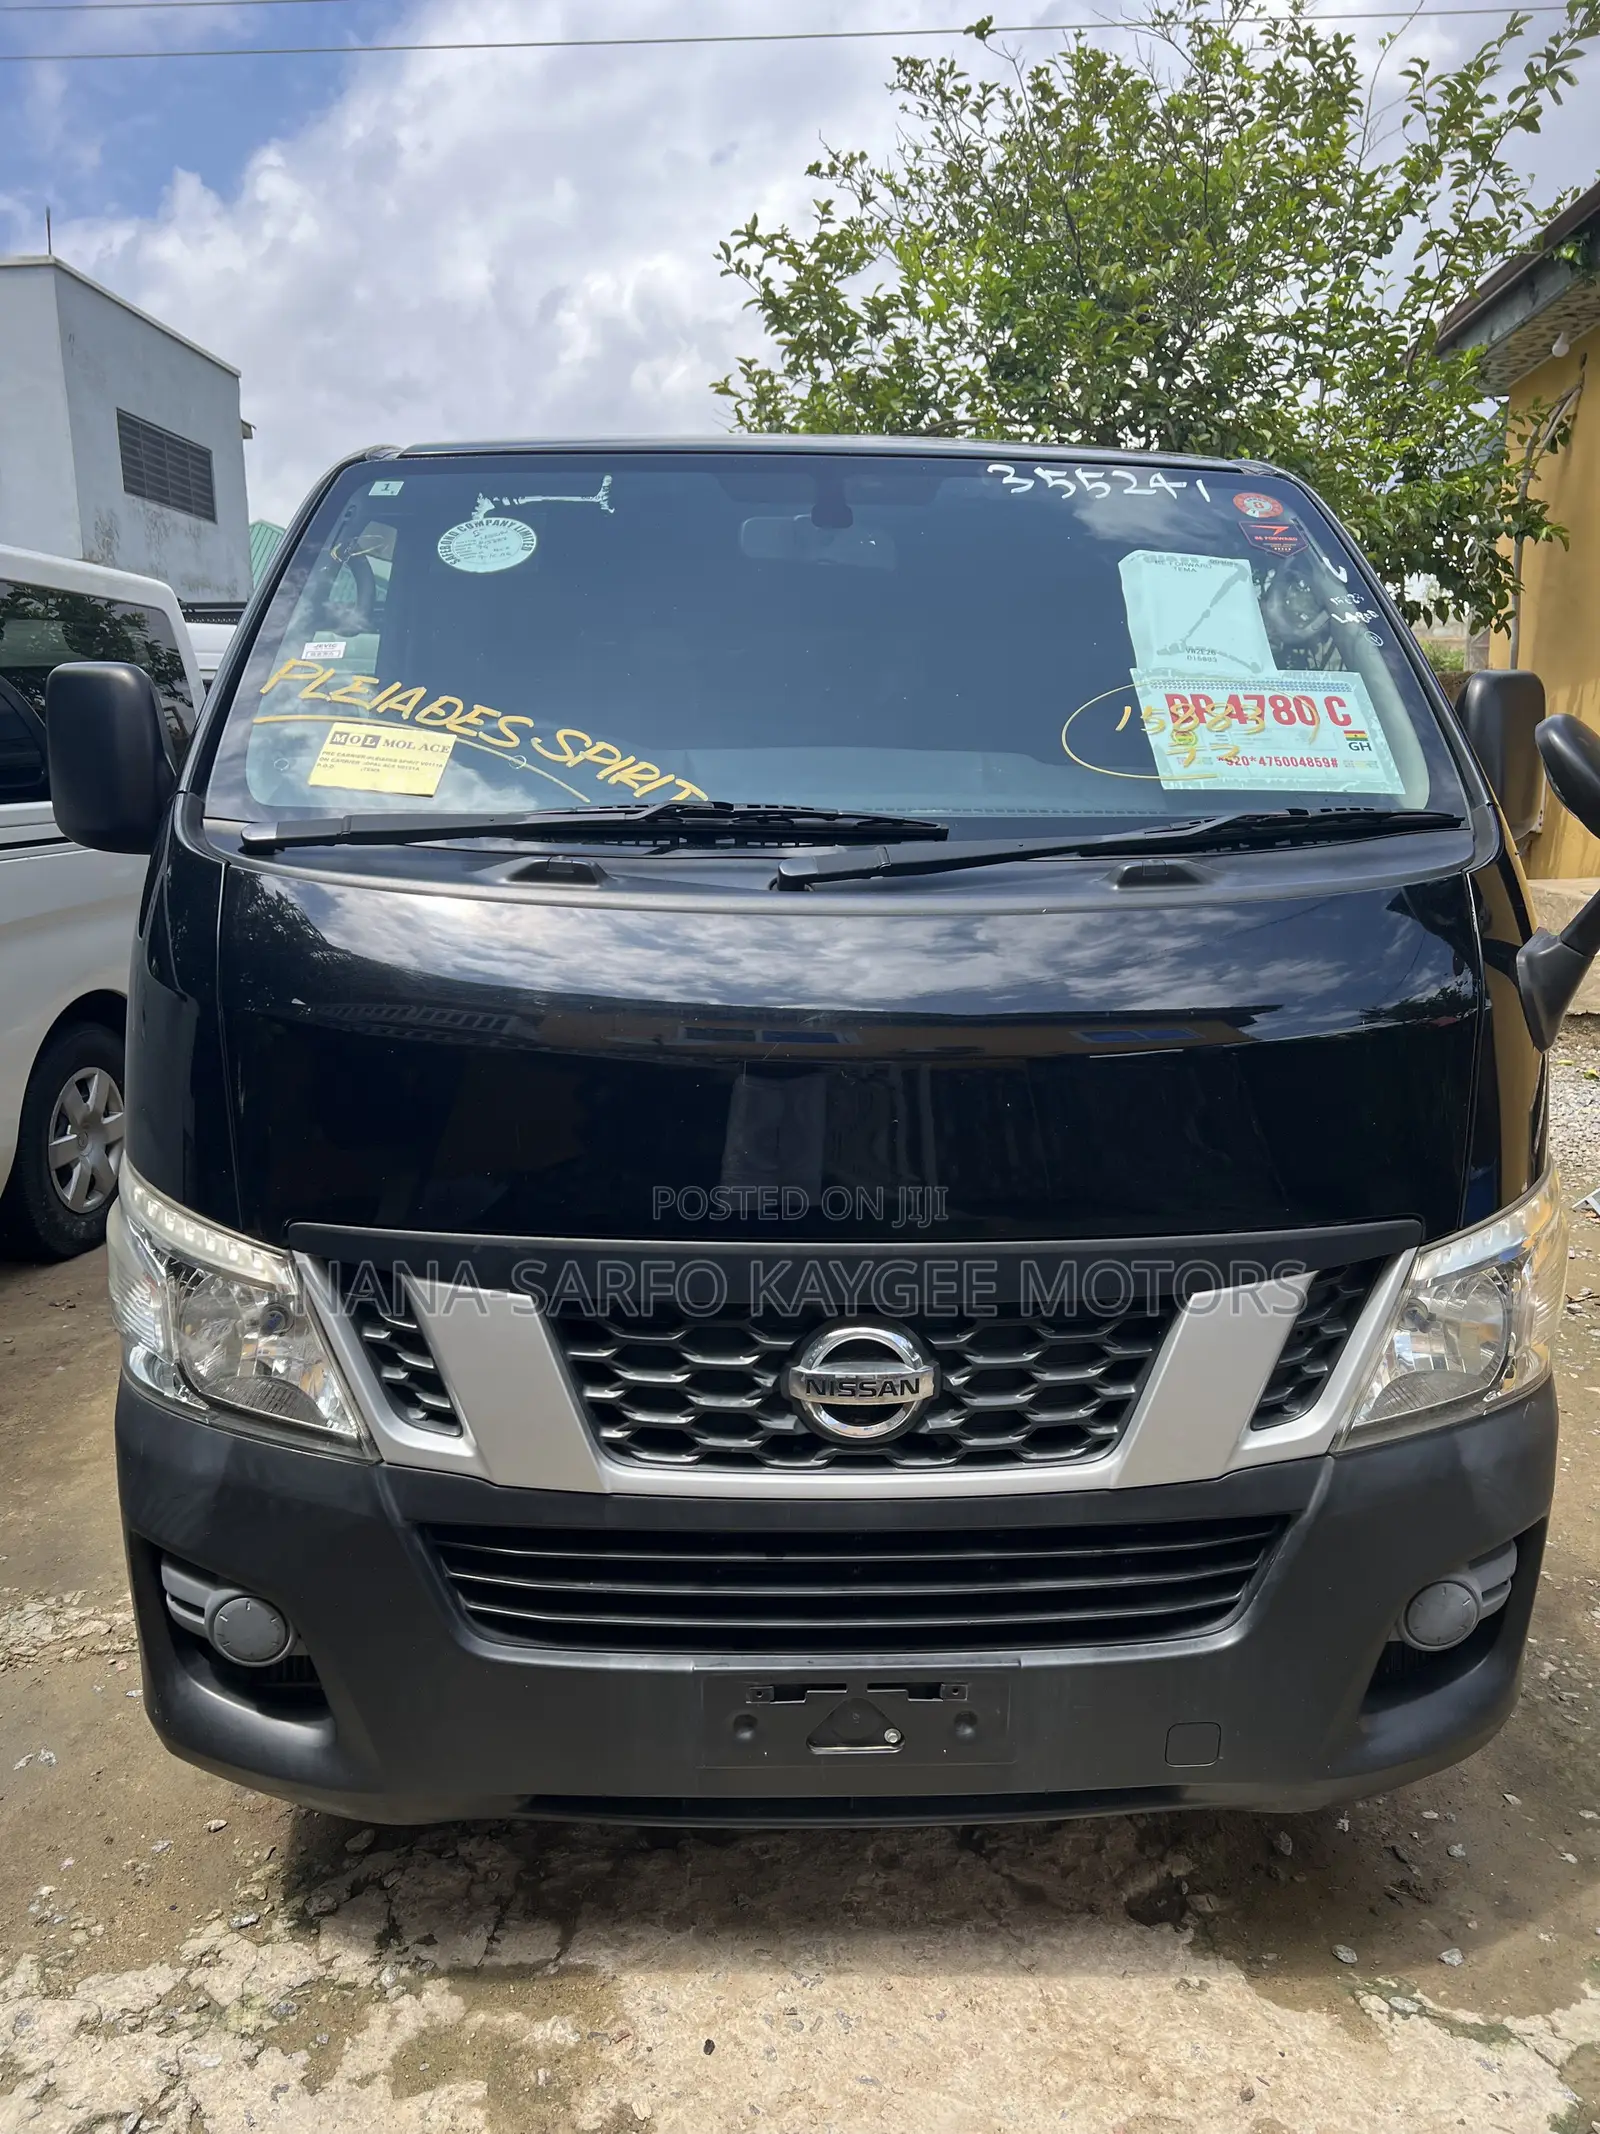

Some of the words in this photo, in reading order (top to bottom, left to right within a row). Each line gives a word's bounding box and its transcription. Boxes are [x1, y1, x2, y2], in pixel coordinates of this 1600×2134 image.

[439, 530, 461, 565] SAFEBOND
[457, 519, 516, 533] COMPANY
[513, 525, 535, 552] LIMITED
[1169, 561, 1213, 569] FORWARD
[1224, 694, 1317, 726] 4780
[1324, 695, 1352, 726] C
[259, 658, 535, 748] PLEIADES
[531, 727, 710, 801] SPIRIT
[329, 731, 382, 749] MOL
[382, 738, 416, 750] MOL
[419, 742, 451, 754] ACE
[1348, 741, 1372, 751] GH
[804, 1376, 921, 1399] NISSAN
